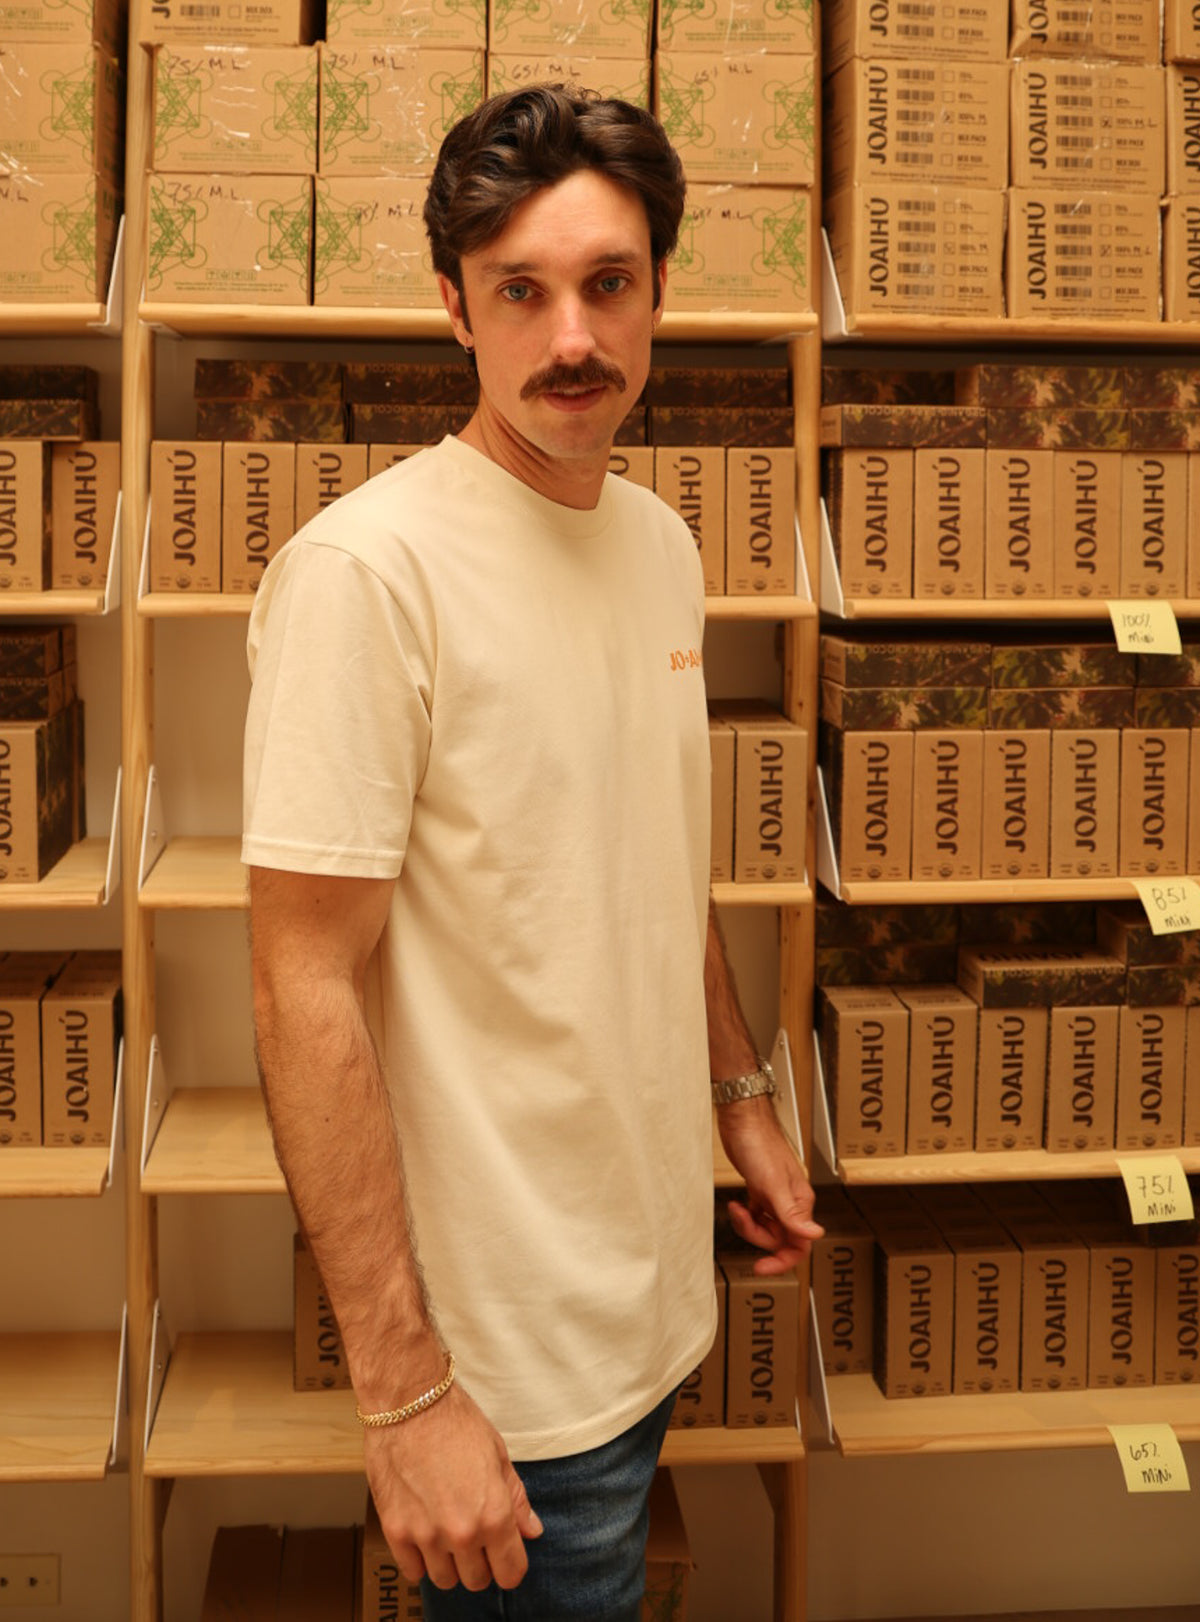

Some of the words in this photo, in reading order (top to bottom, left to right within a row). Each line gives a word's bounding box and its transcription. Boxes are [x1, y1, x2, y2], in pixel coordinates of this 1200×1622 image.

[864, 66, 888, 164] JOAIHÚ
[1023, 72, 1047, 169] JOAIHÚ
[865, 197, 889, 297] JOAIHÚ
[1022, 202, 1047, 299] JOAIHÚ
[68, 451, 97, 564] JOAIHÚ
[167, 450, 197, 566] JOAIHÚ
[240, 452, 270, 569] JOAIHÚ
[744, 455, 772, 568] JOAIHÚ
[860, 456, 889, 573] JOAIHÚ
[932, 457, 961, 573] JOAIHÚ
[1002, 458, 1031, 573] JOAIHÚ
[1069, 460, 1098, 574] JOAIHÚ
[1137, 460, 1165, 573] JOAIHÚ
[754, 740, 784, 857] JOAIHÚ
[860, 741, 890, 857] JOAIHÚ
[931, 740, 960, 856] JOAIHÚ
[998, 738, 1027, 853] JOAIHÚ
[1069, 738, 1097, 853] JOAIHÚ
[1138, 737, 1166, 851] JOAIHÚ
[58, 1010, 90, 1123] JOAIHÚ
[856, 1021, 885, 1134] JOAIHÚ
[927, 1016, 955, 1128] JOAIHÚ
[997, 1015, 1025, 1127] JOAIHÚ
[1067, 1016, 1096, 1128] JOAIHÚ
[1136, 1013, 1164, 1125] JOAIHÚ
[746, 1293, 775, 1403] JOAIHÚ
[827, 1246, 854, 1352] JOAIHÚ
[904, 1264, 932, 1373] JOAIHÚ
[972, 1262, 999, 1370] JOAIHÚ
[1039, 1259, 1067, 1368] JOAIHÚ
[1105, 1256, 1133, 1365] JOAIHÚ
[1172, 1254, 1199, 1361] JOAIHÚ
